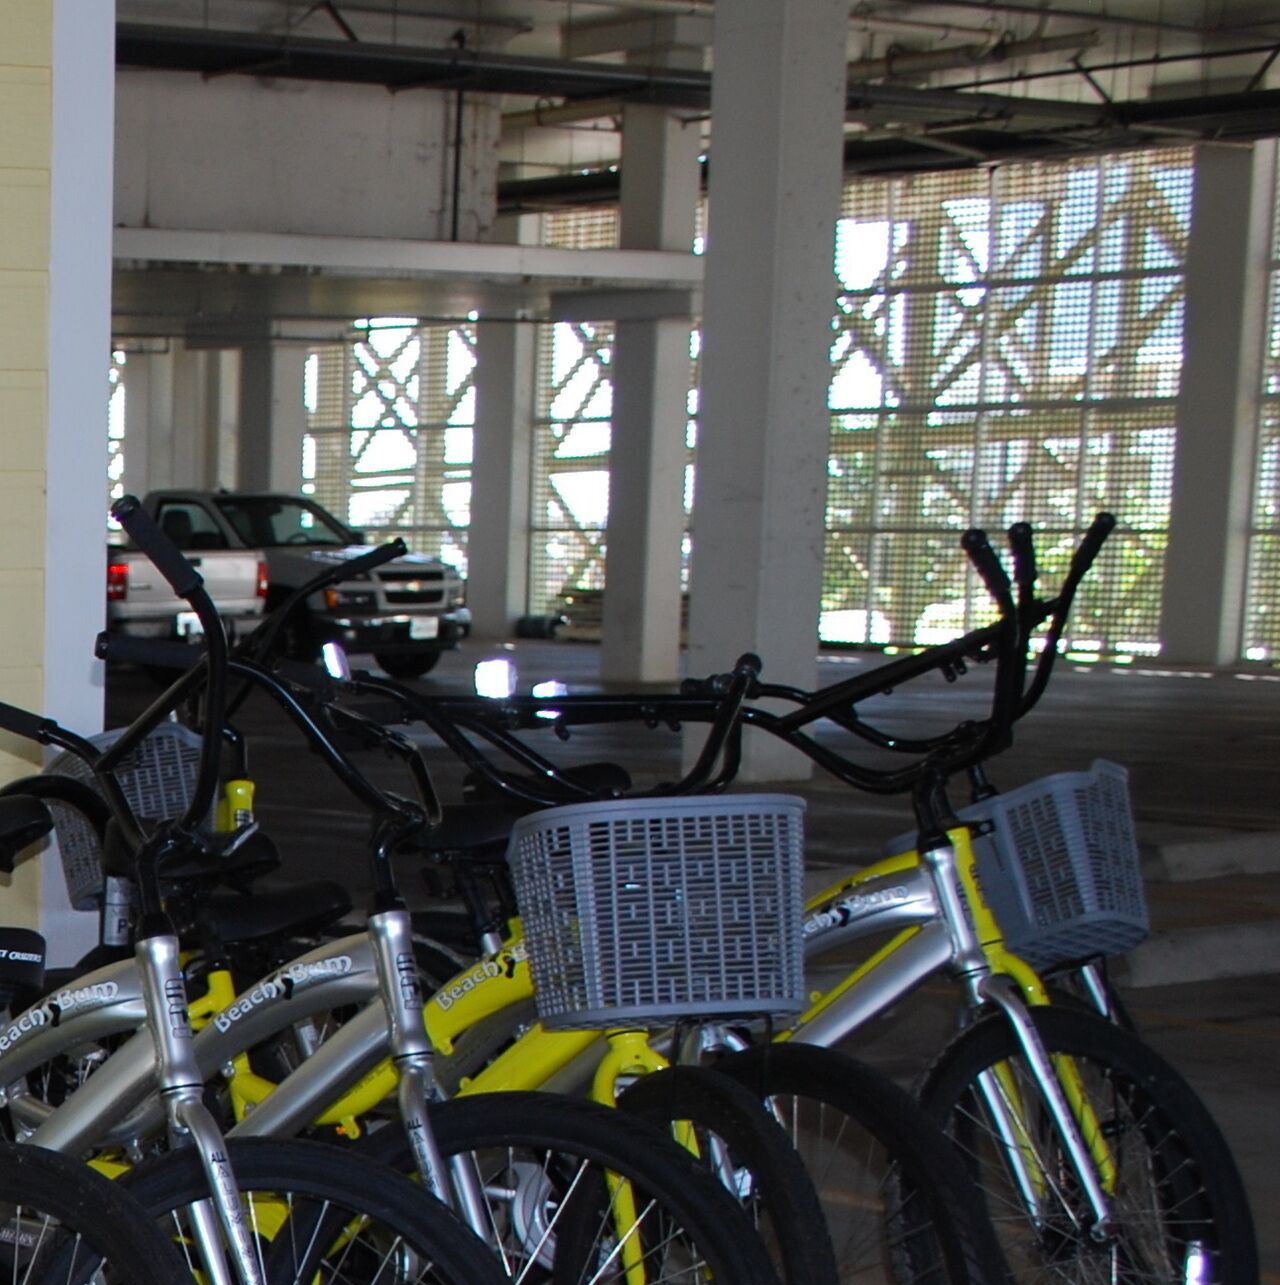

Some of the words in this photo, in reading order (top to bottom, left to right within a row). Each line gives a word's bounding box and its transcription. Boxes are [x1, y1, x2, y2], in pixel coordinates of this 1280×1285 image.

[57, 981, 119, 1011] Bum
[214, 982, 278, 1033] Beach
[289, 955, 352, 984] Bum
[436, 961, 500, 1011] Beach
